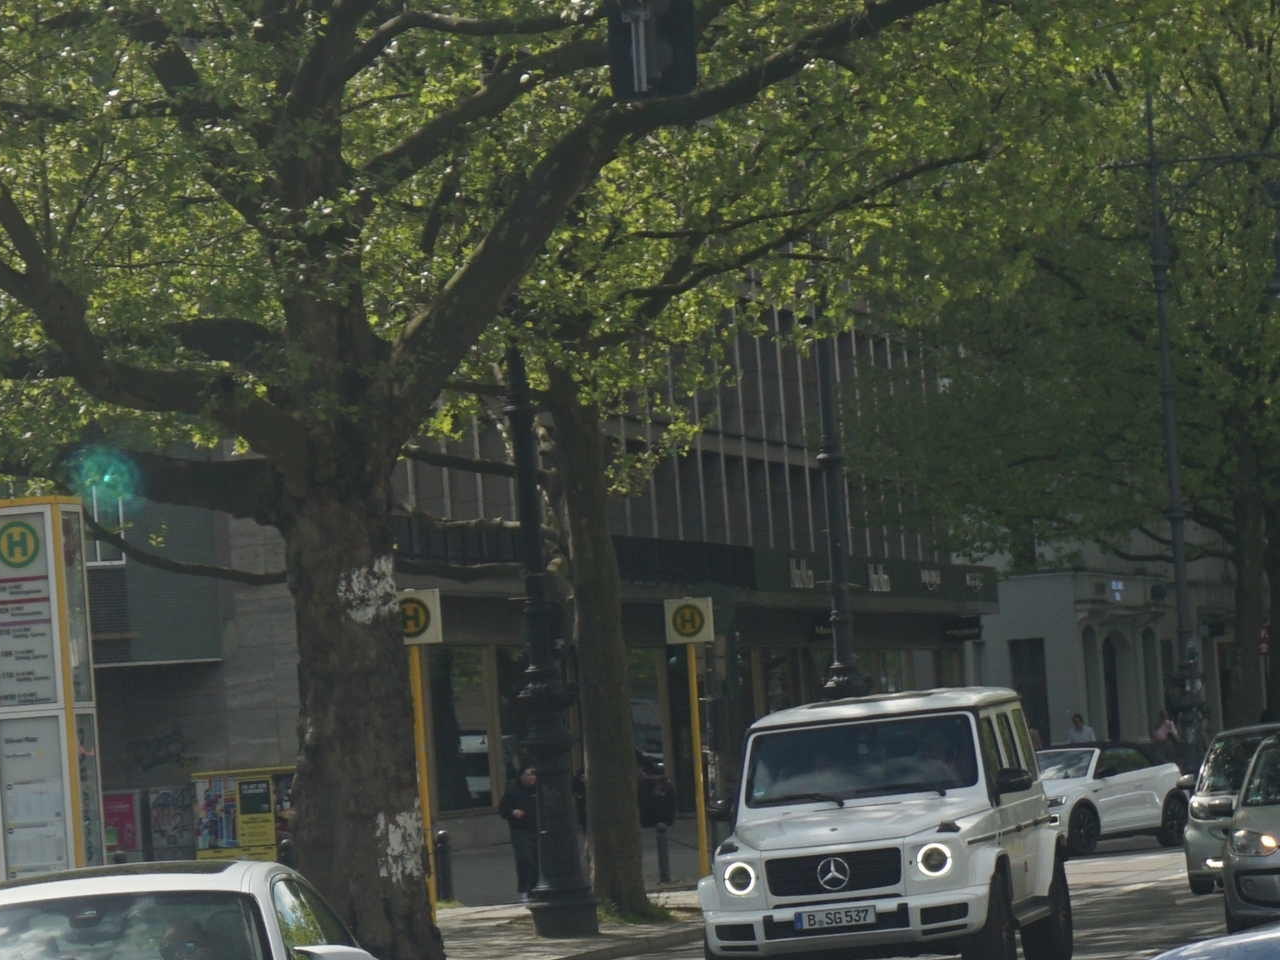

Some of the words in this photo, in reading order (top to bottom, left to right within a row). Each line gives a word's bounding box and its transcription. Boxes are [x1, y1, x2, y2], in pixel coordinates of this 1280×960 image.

[807, 914, 817, 926] B
[825, 911, 843, 925] SG
[845, 909, 869, 923] 537
